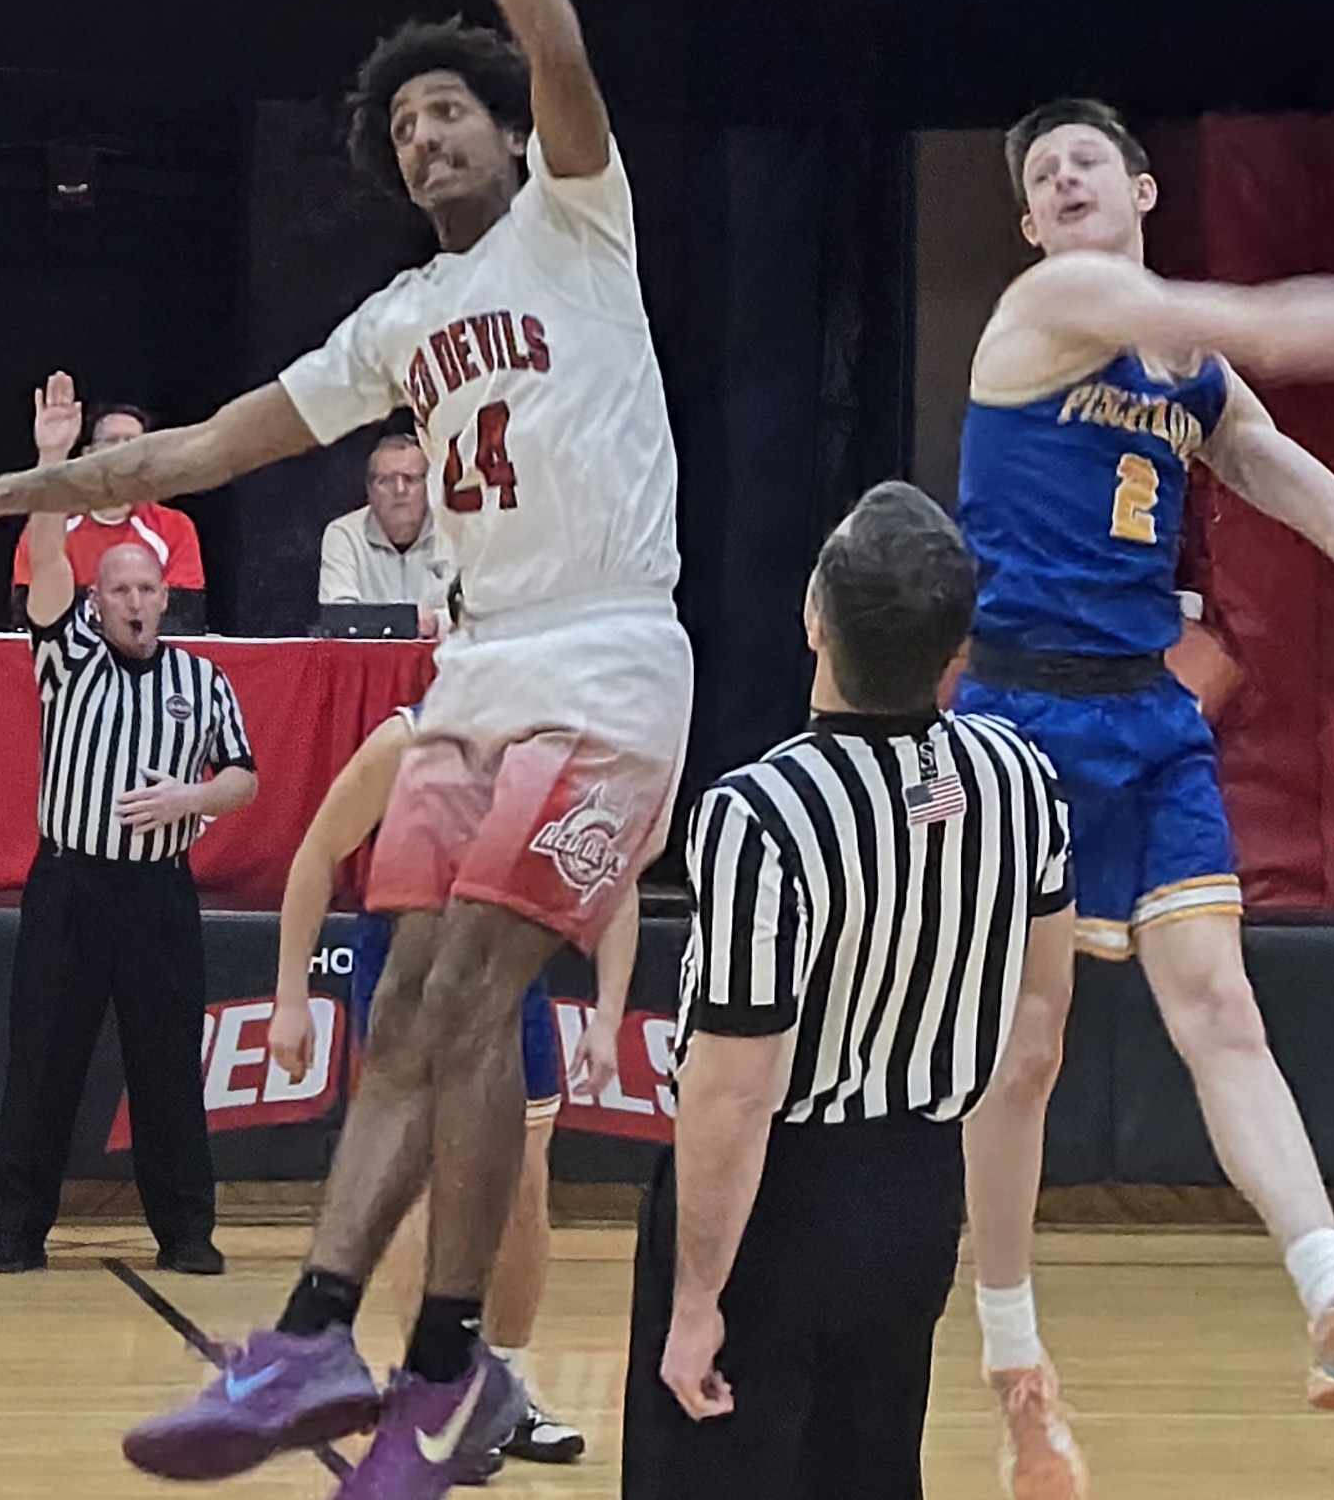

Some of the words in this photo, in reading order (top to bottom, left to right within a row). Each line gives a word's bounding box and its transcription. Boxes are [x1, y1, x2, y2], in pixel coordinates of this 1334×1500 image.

[428, 309, 552, 394] DEVILS
[1109, 452, 1160, 545] 2
[307, 947, 354, 975] HO
[201, 997, 335, 1111] ED
